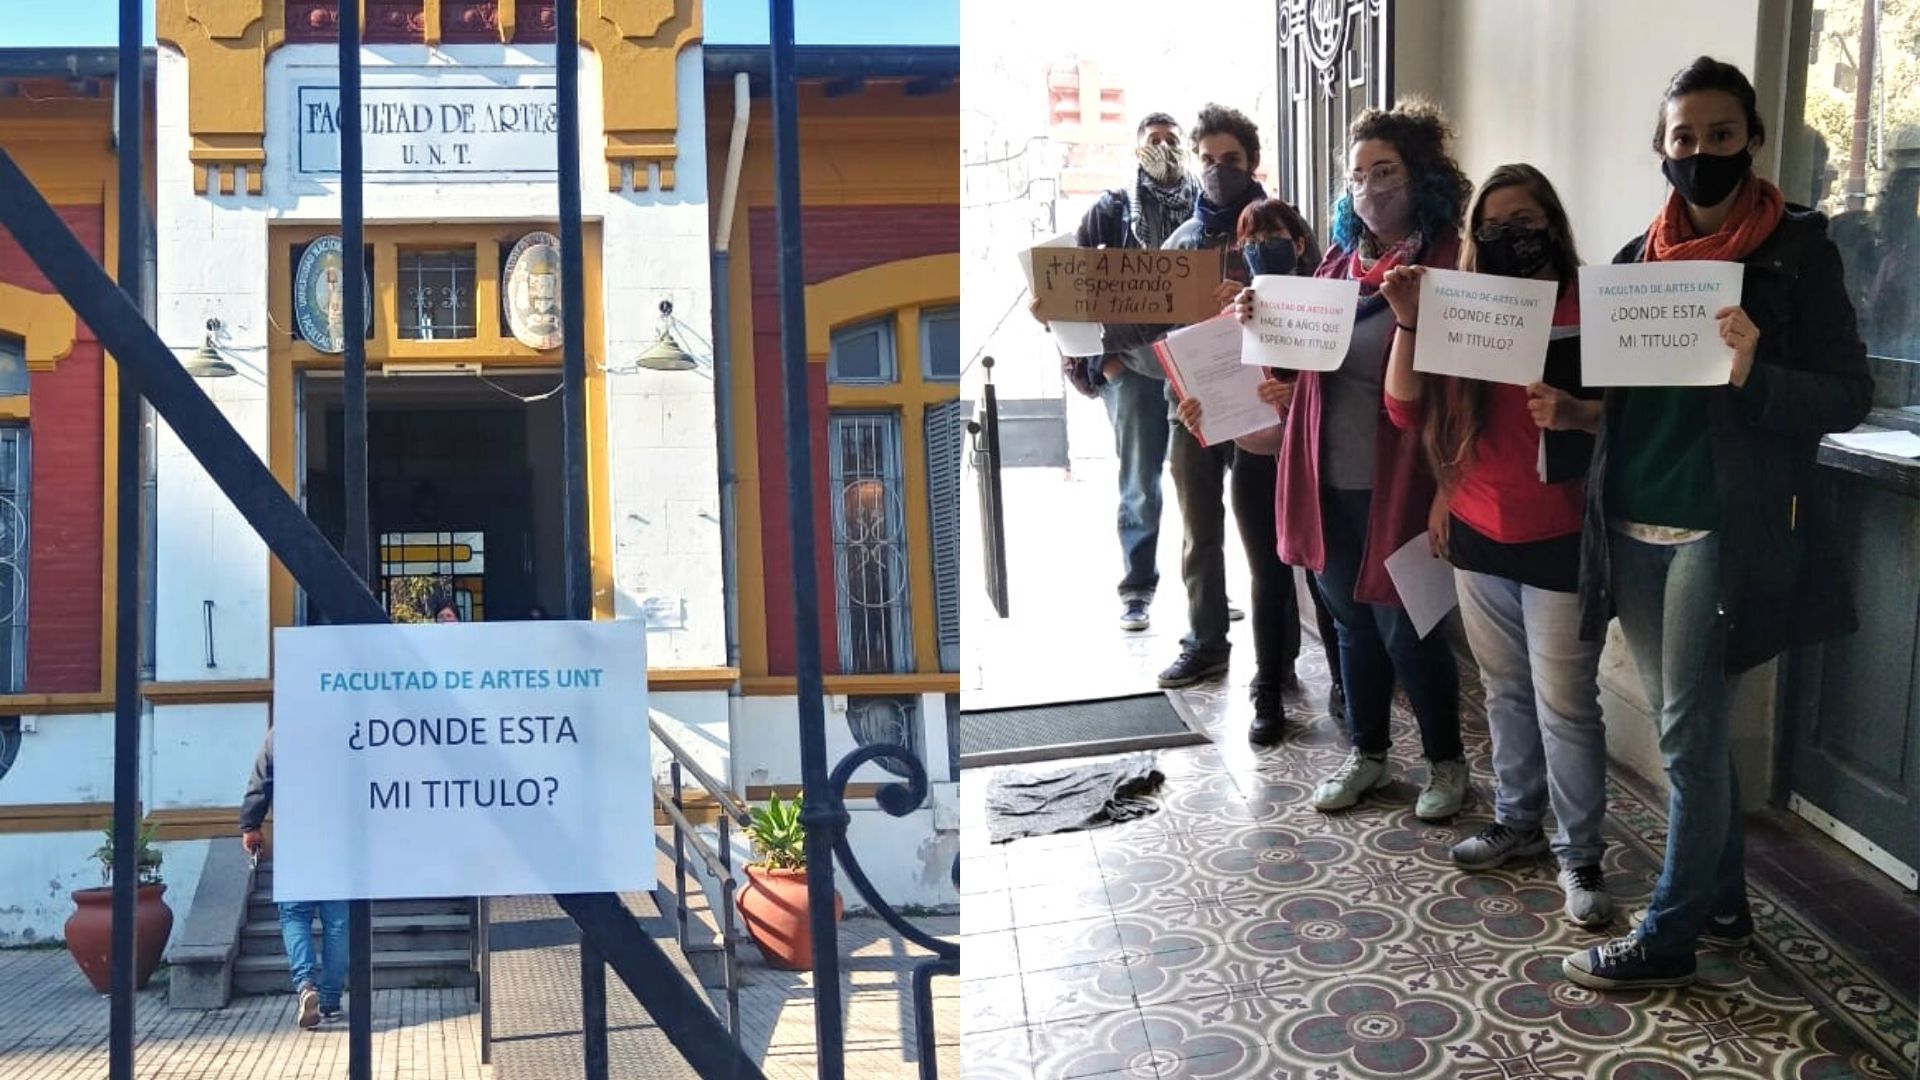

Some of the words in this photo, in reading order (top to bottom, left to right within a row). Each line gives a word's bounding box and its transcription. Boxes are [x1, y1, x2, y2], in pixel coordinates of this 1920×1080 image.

[305, 101, 433, 134] FAULTAD
[440, 103, 476, 133] DE
[402, 144, 419, 165] U.
[428, 143, 446, 165] N.
[453, 143, 472, 164] T.
[1096, 253, 1109, 276] 4
[1120, 251, 1190, 279] AÑOS
[1074, 275, 1172, 297] esperando
[1435, 286, 1478, 301] FACULTAD
[1480, 293, 1492, 302] DE
[1491, 294, 1519, 306] ARTES
[1520, 298, 1538, 308] UNT
[1599, 283, 1648, 296] FACULTAD
[1650, 284, 1663, 294] DE
[1665, 282, 1696, 294] ARTES
[1698, 281, 1721, 293] UNT
[1075, 299, 1097, 313] mi
[1611, 305, 1669, 322] ¿DONDE
[1672, 304, 1707, 319] ESTA
[1260, 315, 1283, 328] HACE
[1295, 318, 1322, 332] AÑOS
[1322, 322, 1340, 333] QUE
[1443, 306, 1492, 324] ¿DONDE
[1494, 312, 1525, 329] ESTA
[1259, 333, 1293, 346] ESPERO
[1294, 335, 1304, 348] MI
[1304, 337, 1337, 351] TITULO
[1447, 331, 1463, 344] MI
[1466, 332, 1515, 351] TITULO?
[1619, 334, 1637, 348] MI
[1640, 332, 1699, 349] TITULO?
[319, 670, 438, 692] FACULTAD
[444, 670, 473, 690] DE
[480, 669, 551, 690] ARTES
[557, 668, 604, 688] UNT
[348, 717, 488, 751] ¿DONDE
[500, 715, 579, 744] ESTA
[369, 781, 411, 810] MI
[422, 776, 560, 809] TITULO?
